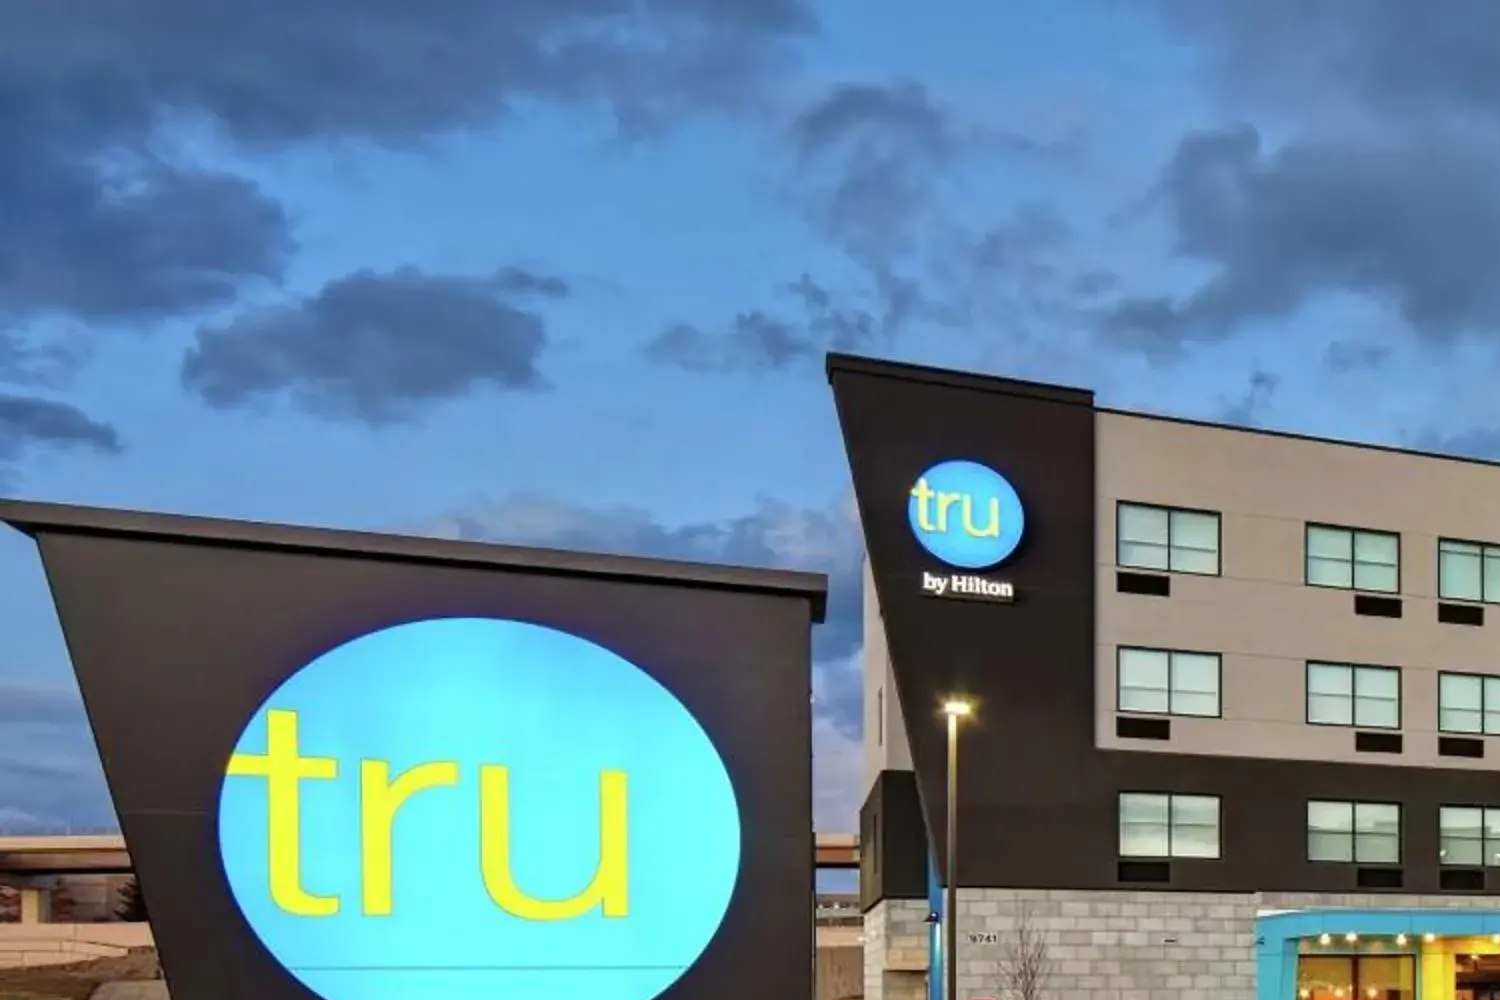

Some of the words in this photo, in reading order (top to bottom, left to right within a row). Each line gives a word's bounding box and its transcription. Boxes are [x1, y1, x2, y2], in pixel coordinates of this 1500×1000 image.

[910, 477, 999, 537] tru
[922, 571, 949, 595] by
[951, 574, 1014, 597] Hilton
[226, 710, 629, 921] tru
